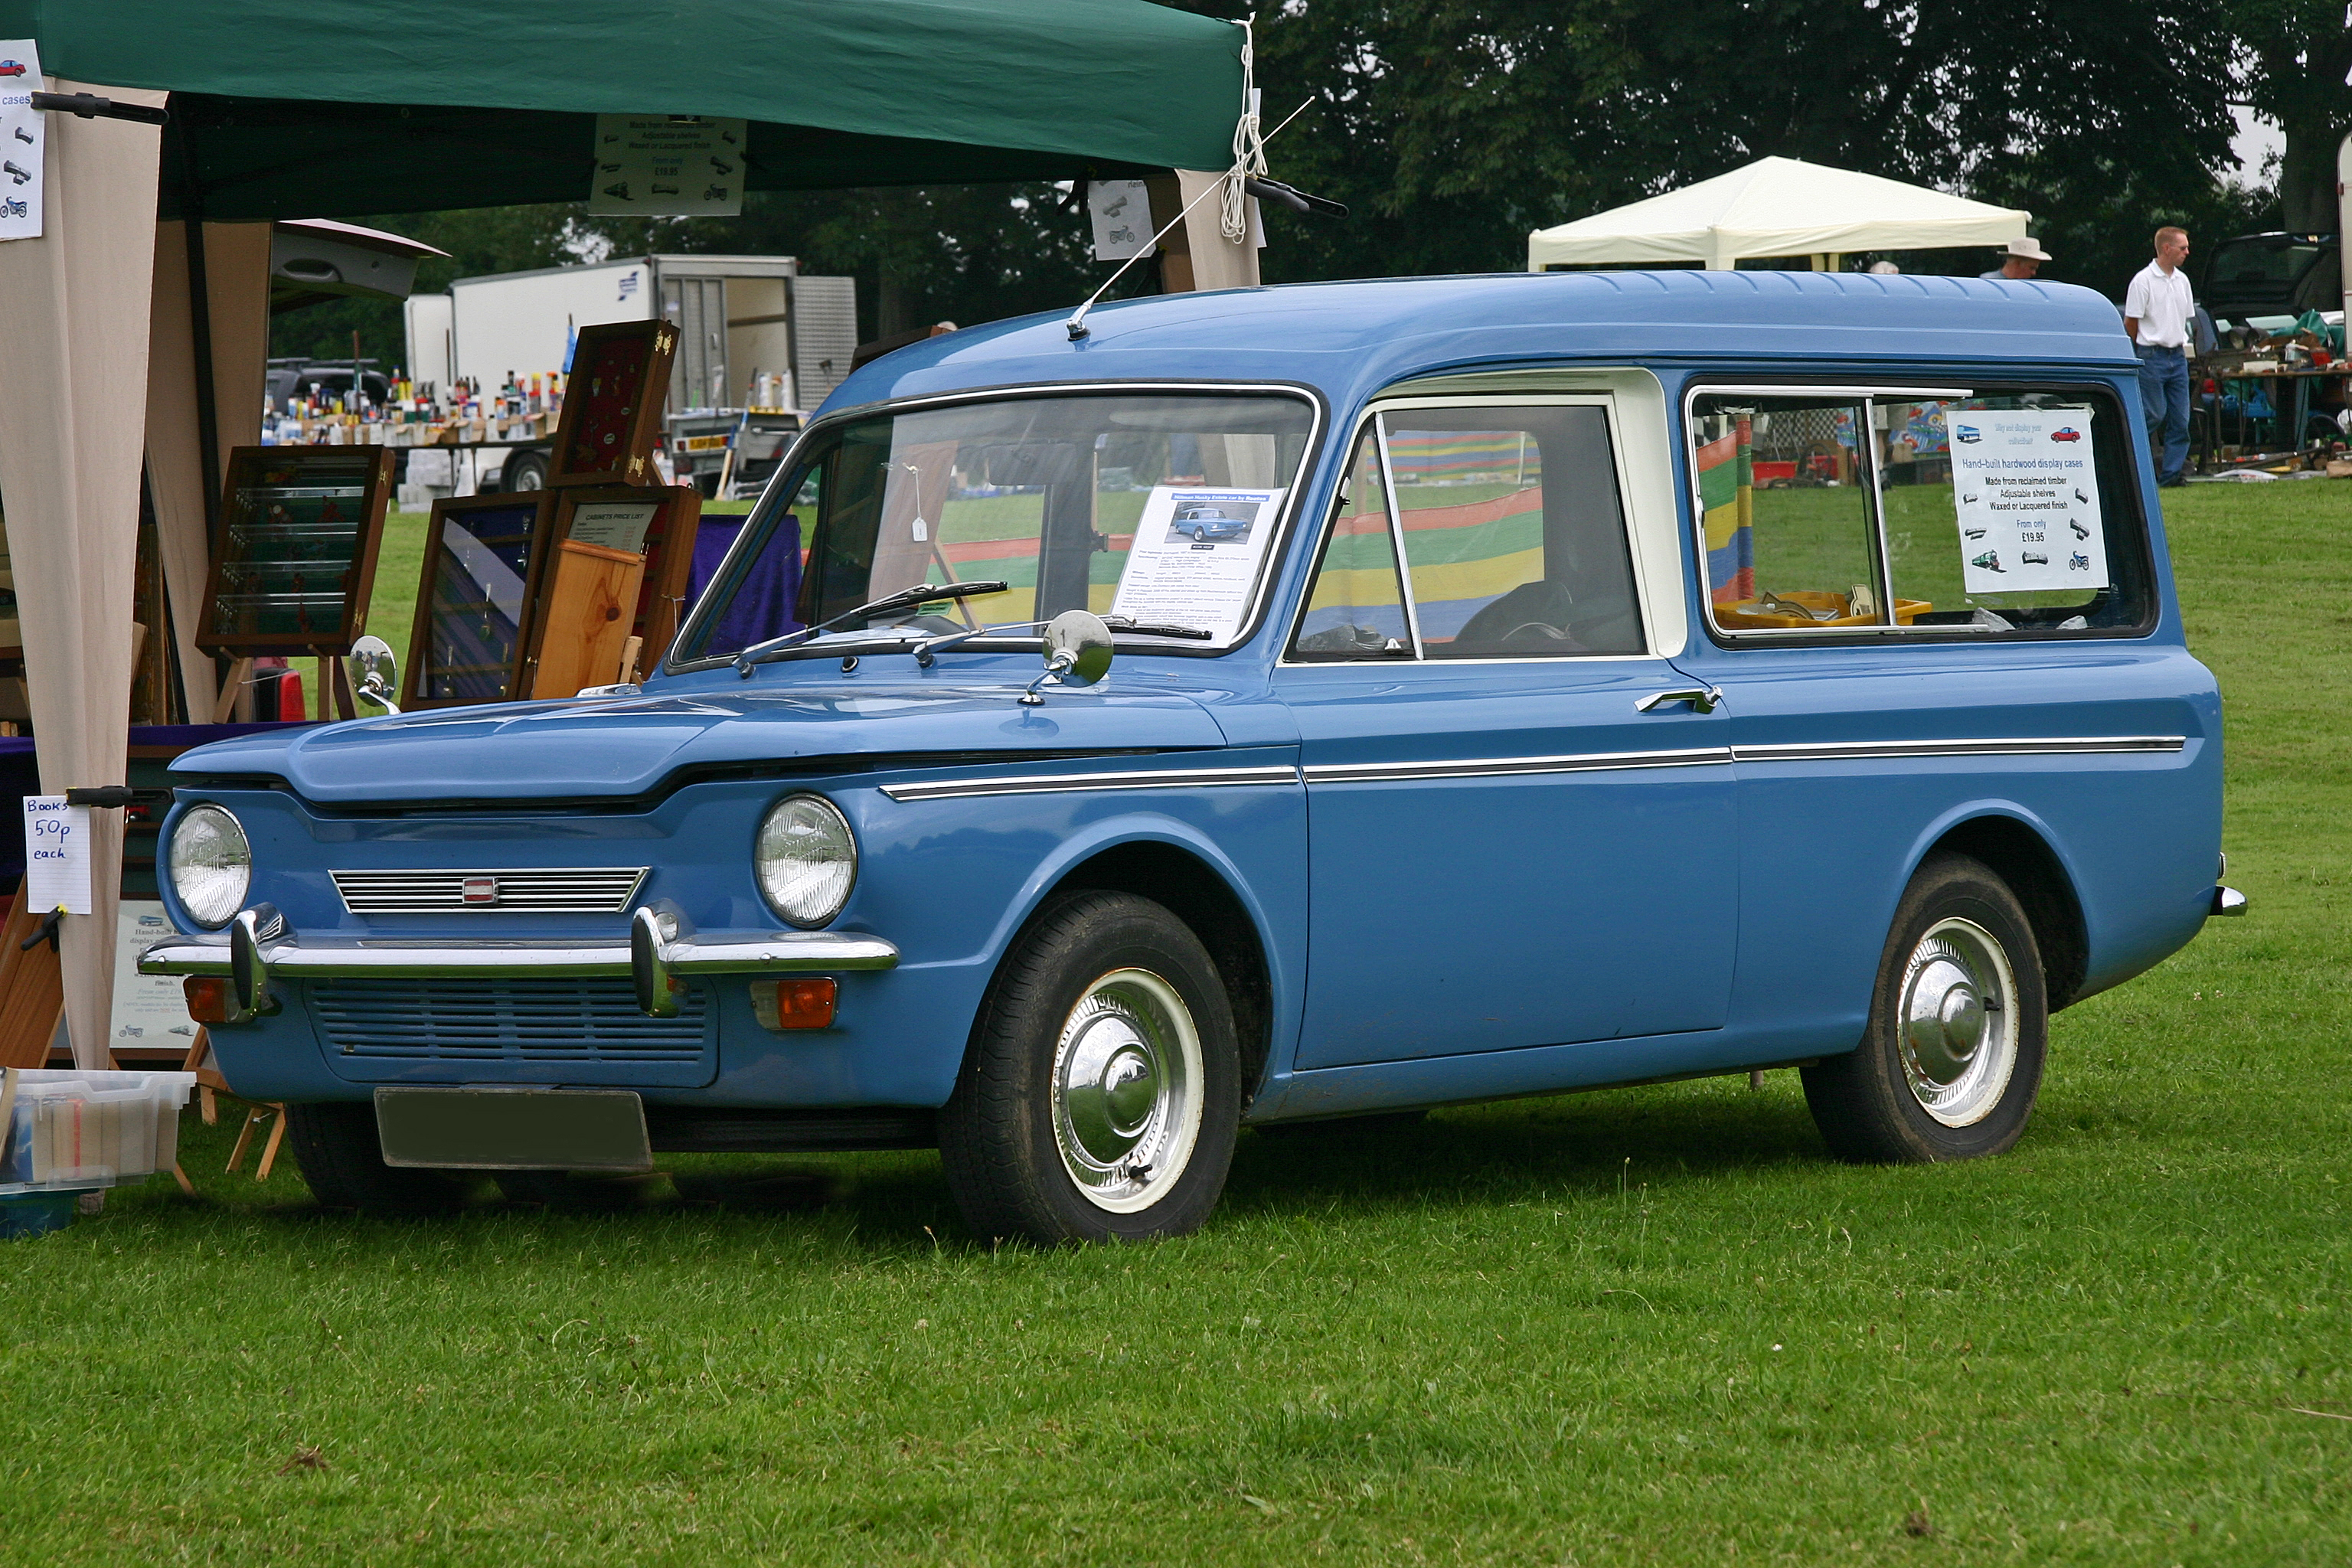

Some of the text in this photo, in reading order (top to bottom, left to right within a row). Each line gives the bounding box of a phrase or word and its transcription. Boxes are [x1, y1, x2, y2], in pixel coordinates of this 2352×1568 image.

[2, 96, 31, 105] cases
[1962, 458, 2083, 469] Hand-built hardwood display cases
[1985, 476, 2066, 485] Made from reclaimed timber
[2000, 488, 2056, 500] Adjustable shelves
[1989, 501, 2011, 511] Waxed
[2020, 501, 2050, 511] Lacquered
[2052, 501, 2068, 510] finish
[2017, 519, 2047, 530] From only
[2022, 531, 2045, 543] £19.95
[28, 799, 68, 812] Books
[35, 819, 70, 844] 50p
[34, 848, 66, 859] each
